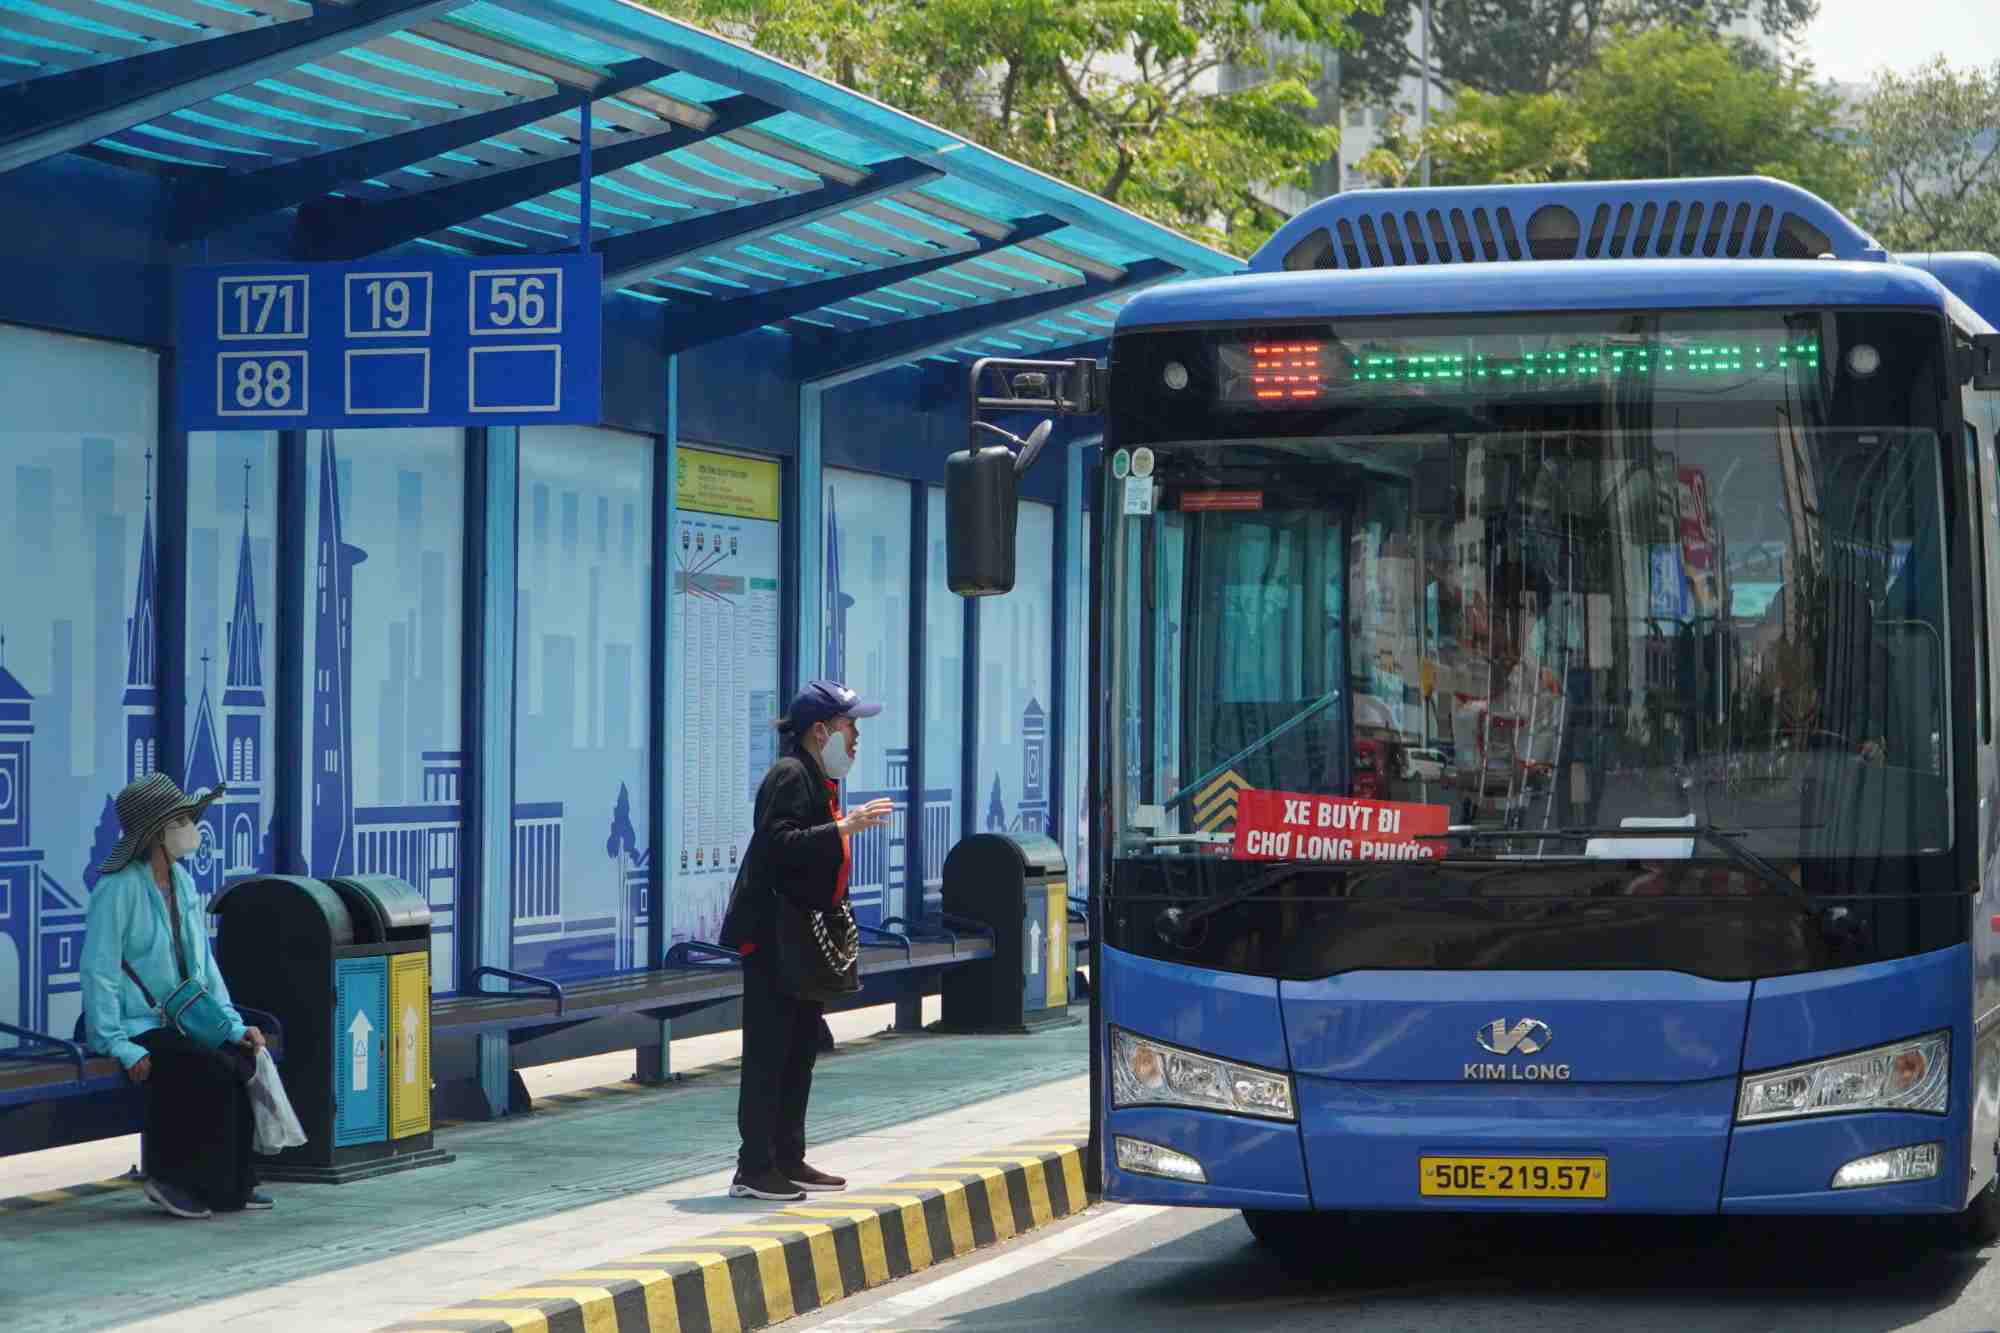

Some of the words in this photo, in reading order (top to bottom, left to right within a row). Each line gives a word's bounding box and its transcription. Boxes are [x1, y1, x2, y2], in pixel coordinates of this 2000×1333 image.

[234, 285, 294, 333] 171
[366, 280, 410, 329] 19
[489, 277, 545, 326] 56
[236, 360, 291, 407] 88
[1283, 799, 1311, 825] XE
[1317, 801, 1373, 831] BUÝT
[1378, 808, 1400, 834] ĐI
[1296, 834, 1353, 861] LONG
[1464, 1063, 1506, 1079] KIM
[1512, 1063, 1570, 1080] LONG
[1435, 1164, 1591, 1191] 50E-219.57
